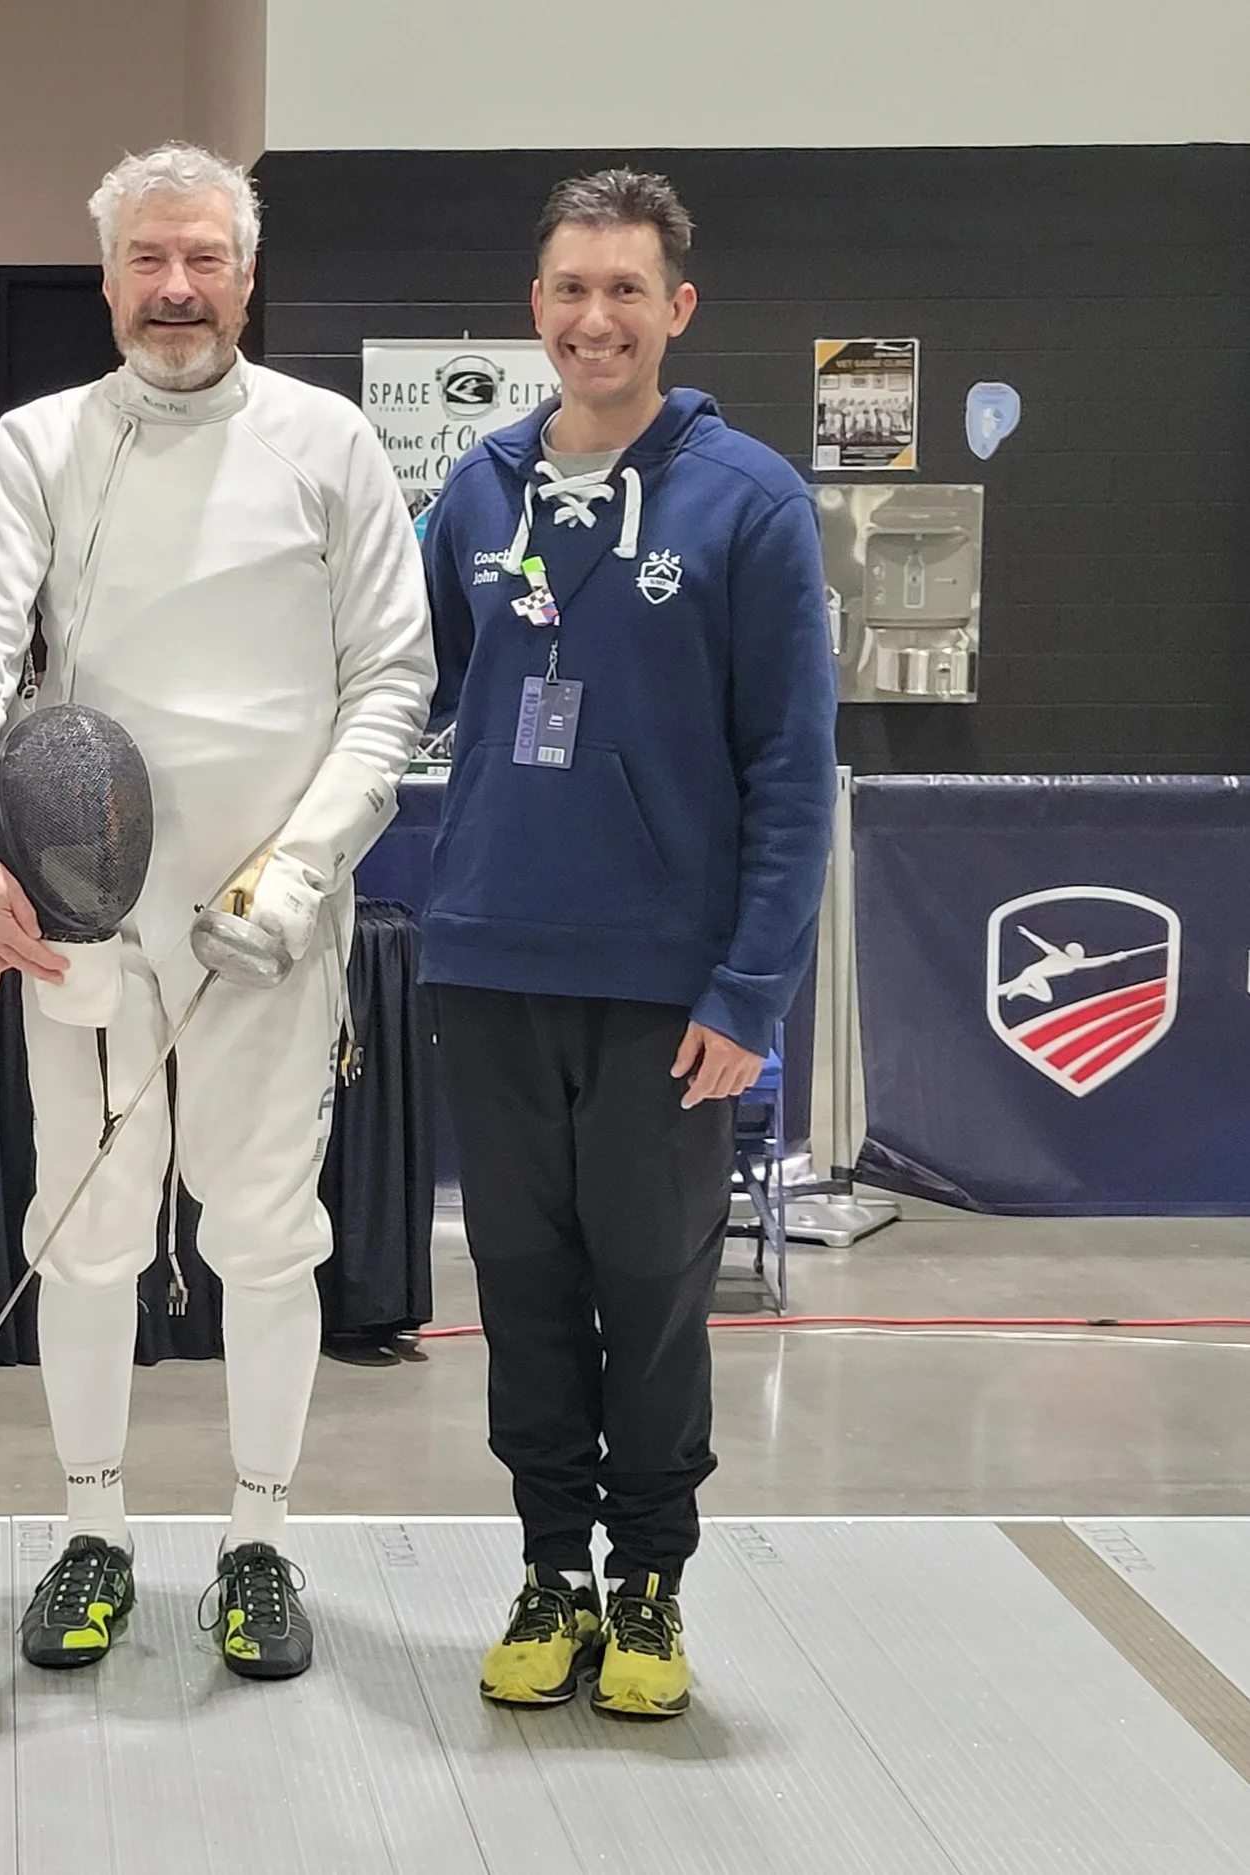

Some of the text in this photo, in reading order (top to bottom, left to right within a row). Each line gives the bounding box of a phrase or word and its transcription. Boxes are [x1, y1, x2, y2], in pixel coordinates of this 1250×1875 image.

[369, 383, 430, 405] SPACE
[431, 424, 453, 453] of
[472, 569, 499, 585] John
[519, 690, 541, 750] COACH
